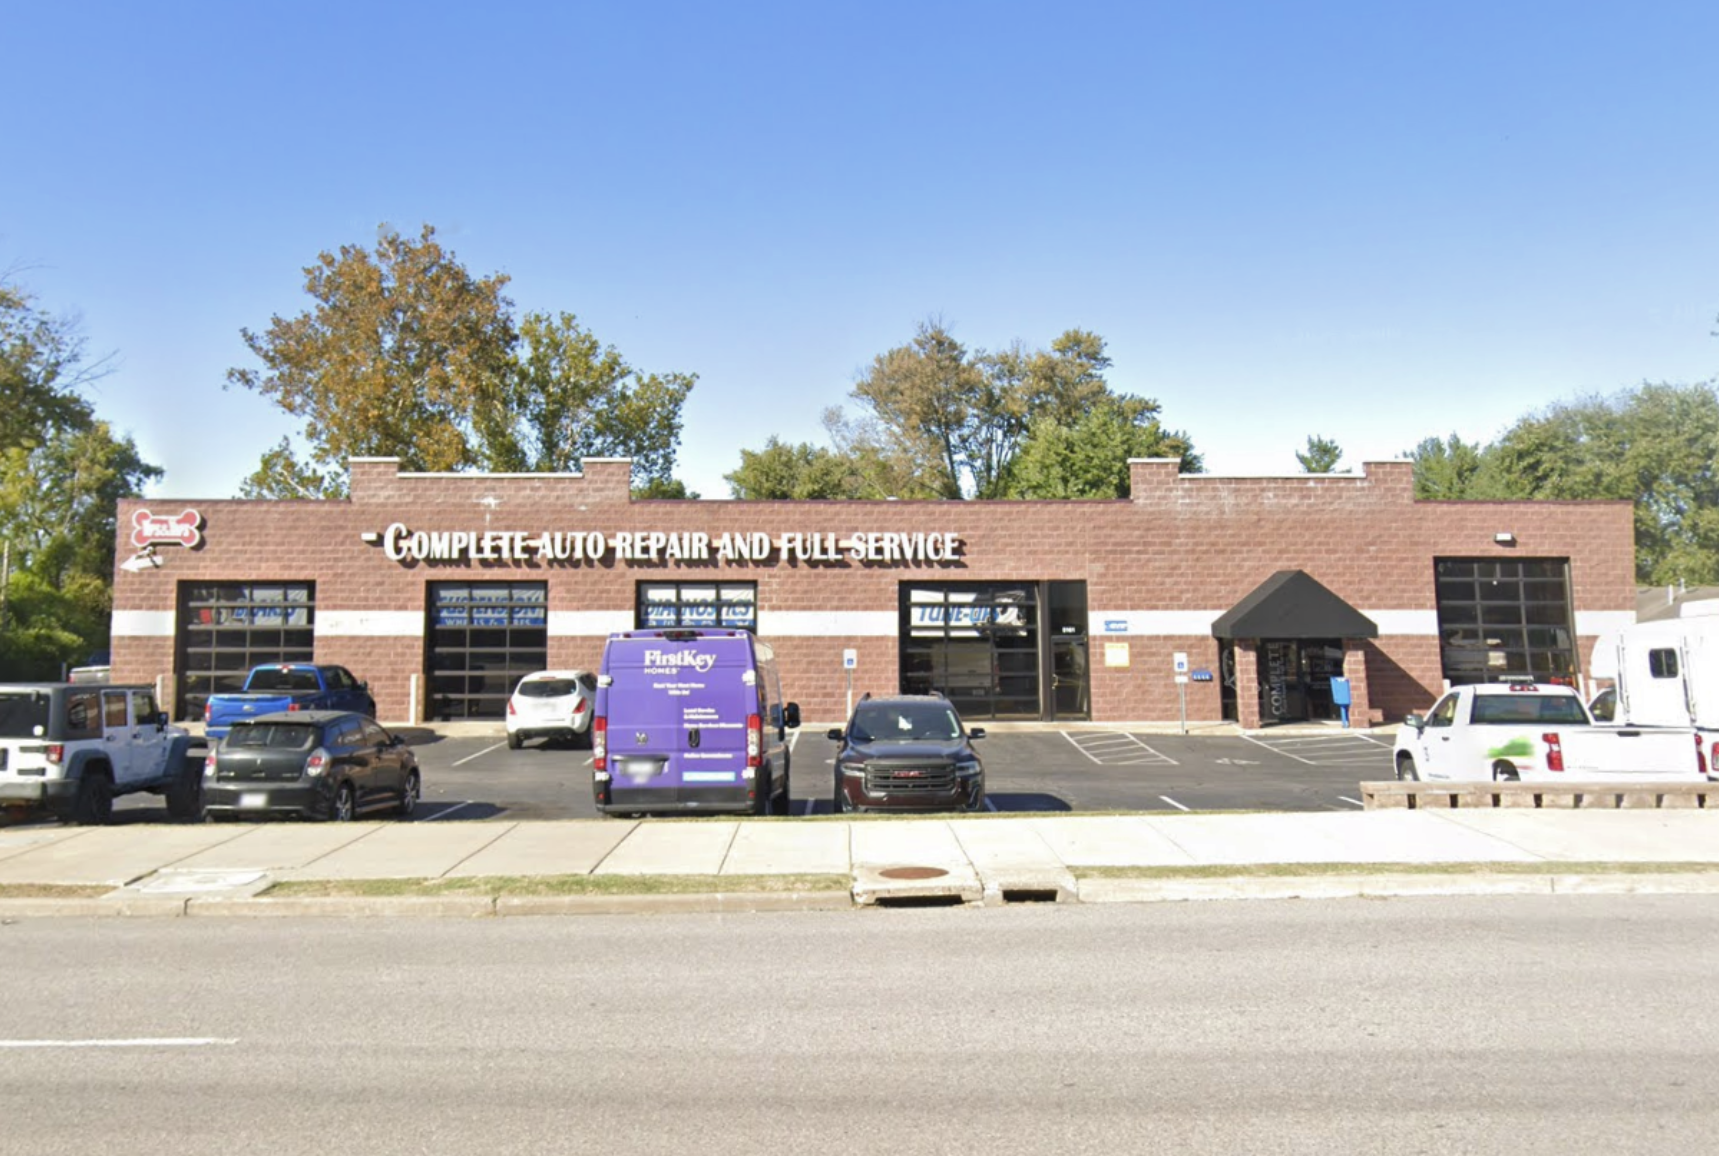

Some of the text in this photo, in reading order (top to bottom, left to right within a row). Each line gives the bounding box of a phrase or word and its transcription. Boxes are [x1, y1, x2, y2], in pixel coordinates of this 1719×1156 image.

[383, 522, 960, 560] COMPLETE AUTO REPAIR AND FULL SERVICE
[439, 596, 542, 614] SUSPENSON
[643, 598, 752, 616] DIANOSICS
[644, 650, 717, 672] FirstKey
[644, 667, 677, 675] HOMES
[1267, 642, 1282, 716] COMPLETE
